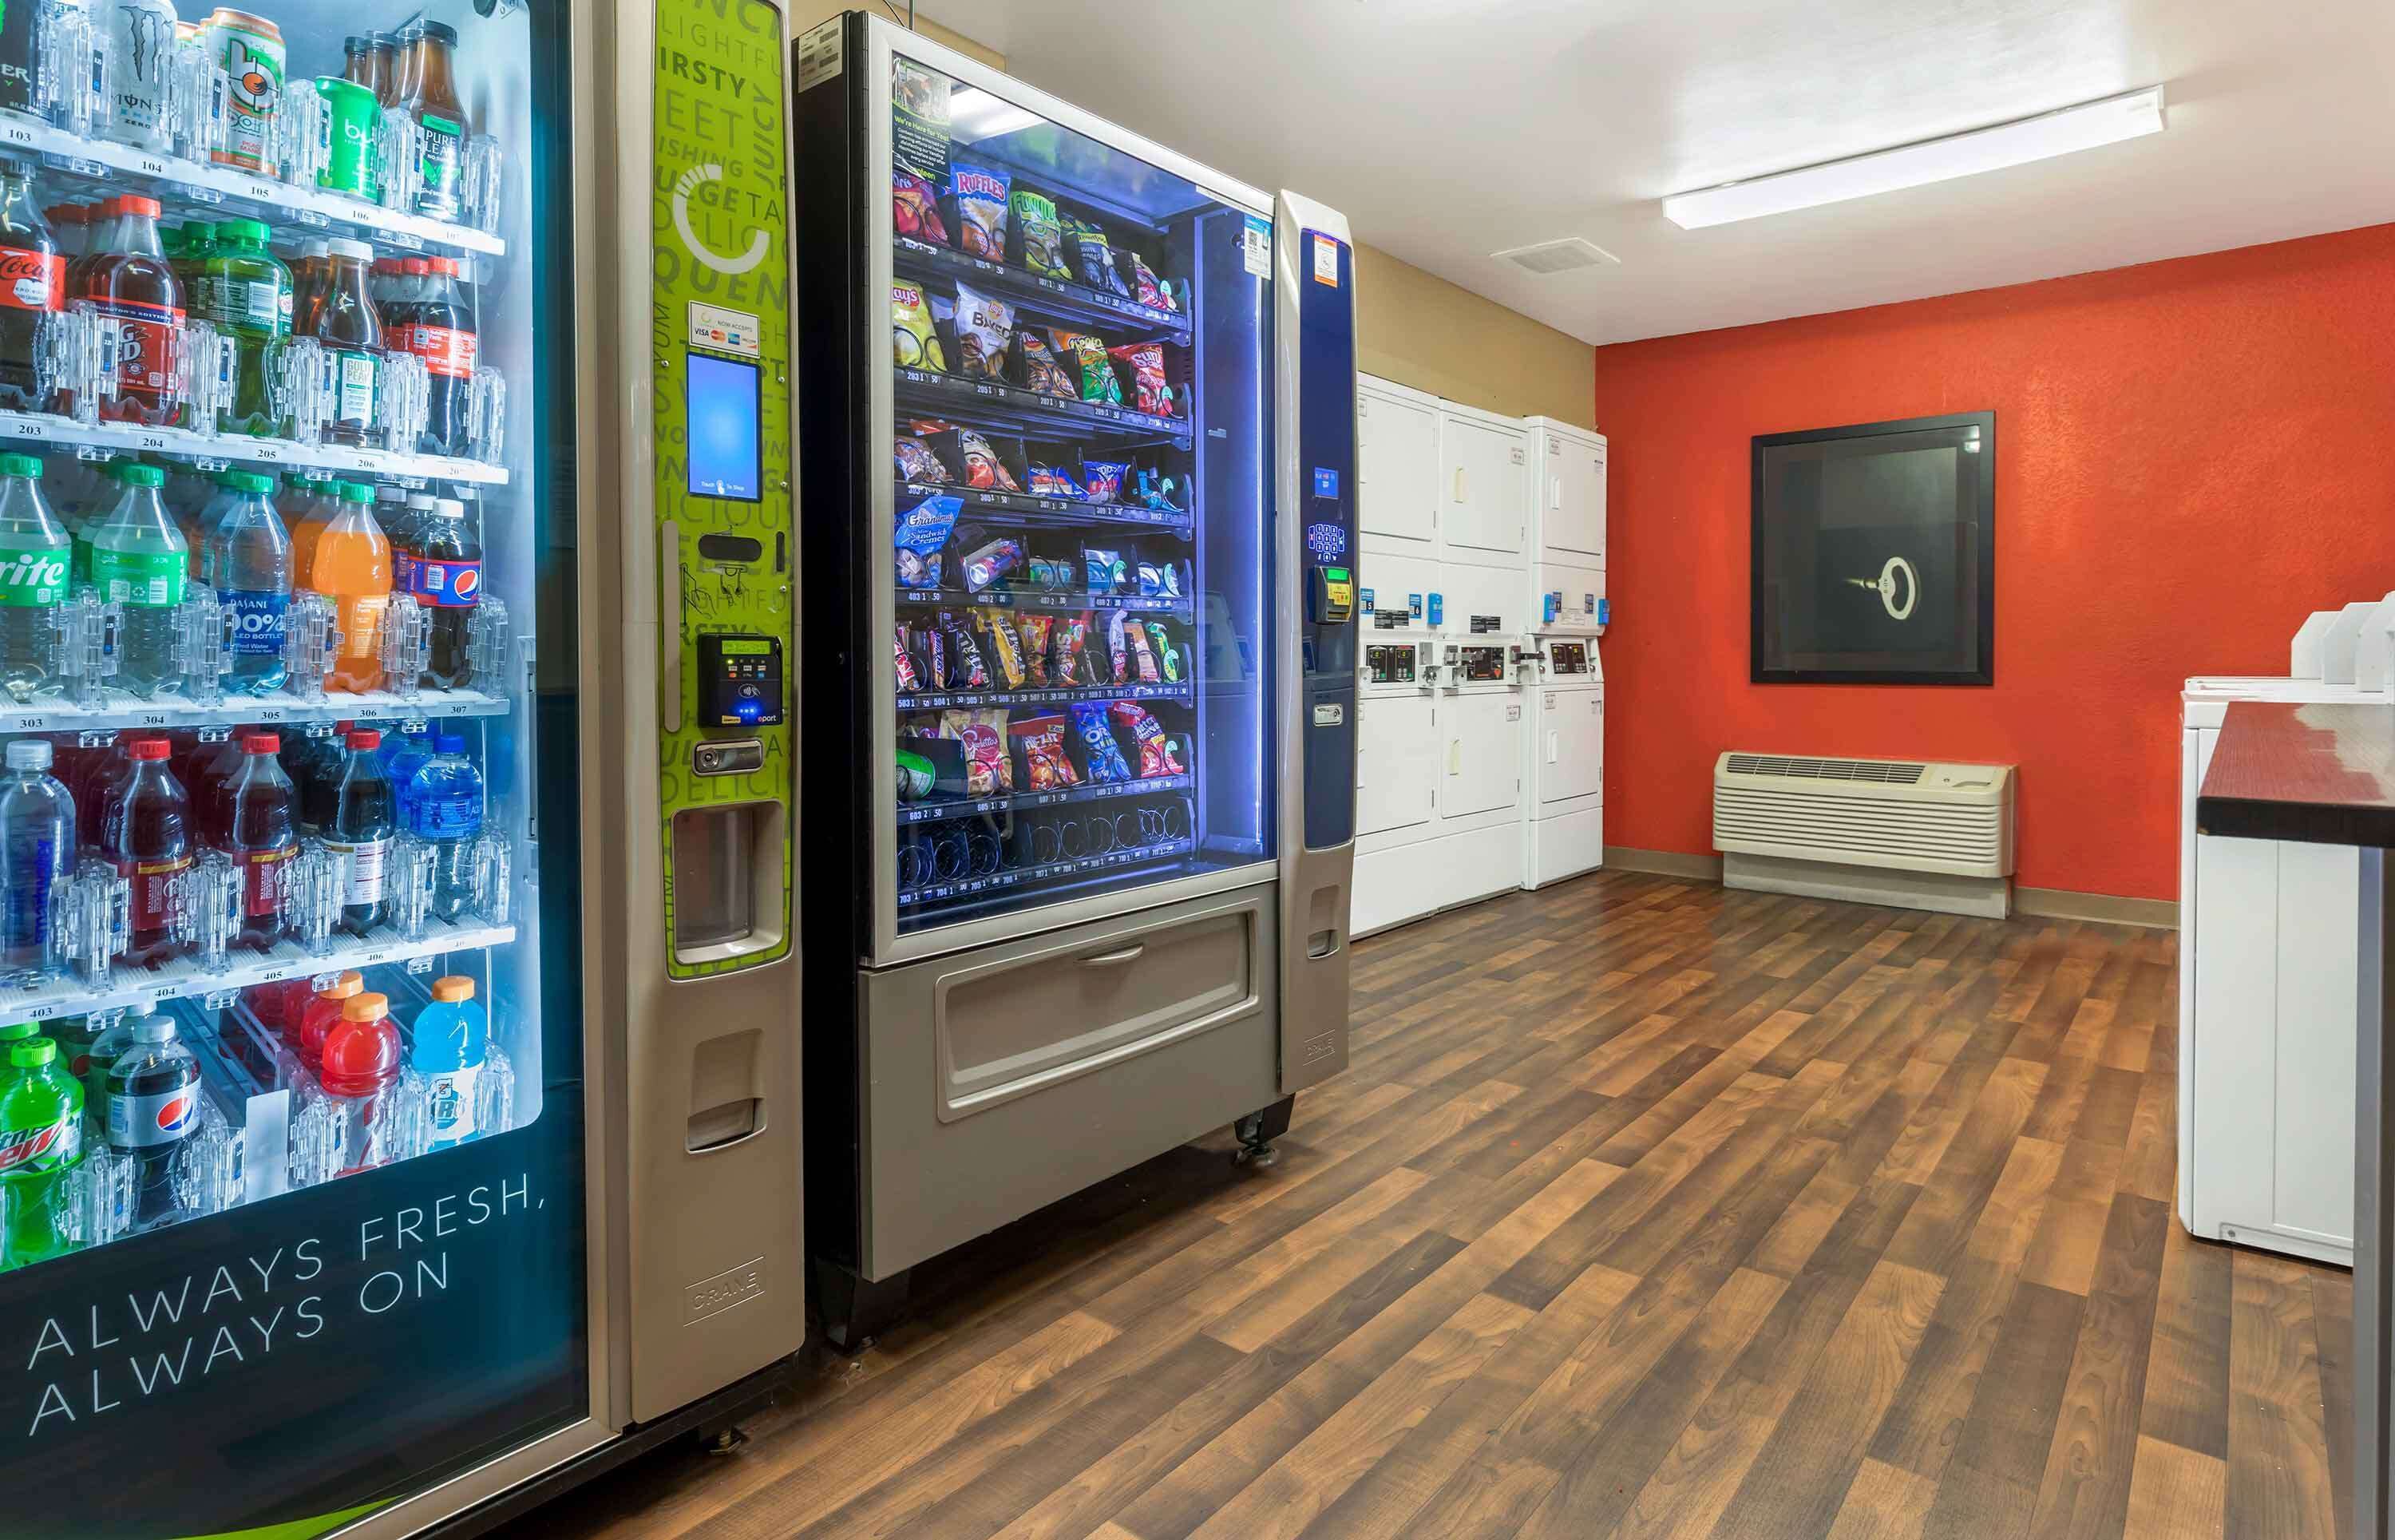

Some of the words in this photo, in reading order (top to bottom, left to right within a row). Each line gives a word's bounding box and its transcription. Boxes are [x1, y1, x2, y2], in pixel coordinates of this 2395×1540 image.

[660, 46, 746, 98] IRSTY
[125, 119, 151, 129] ZERO
[665, 89, 743, 149] EET
[9, 129, 31, 142] 103
[426, 129, 457, 145] PURE
[142, 160, 162, 173] 104
[251, 185, 270, 198] 105
[957, 172, 1006, 200] RUFFLES
[353, 210, 369, 221] 106
[972, 311, 1011, 340] BAKED
[695, 327, 709, 336] VISA
[18, 424, 42, 436] 203
[142, 437, 164, 448] 204
[257, 448, 277, 460] 205
[358, 458, 375, 469] 206
[909, 528, 947, 540] Sandwich
[910, 535, 945, 546] Cremes
[230, 598, 267, 609] DASANI
[261, 711, 279, 720] 305
[359, 708, 377, 718] 306
[450, 705, 467, 715] 307
[19, 719, 43, 729] 303
[143, 715, 164, 725] 304
[366, 953, 384, 962] 406
[263, 970, 282, 980] 405
[154, 987, 176, 997] 404
[30, 1007, 53, 1018] 403
[28, 1238, 323, 1371] ALWAYS
[362, 1173, 545, 1261] FRESH,
[693, 1271, 758, 1310] CRANE
[29, 1297, 323, 1436] ALWAYS
[360, 1252, 449, 1314] ON
